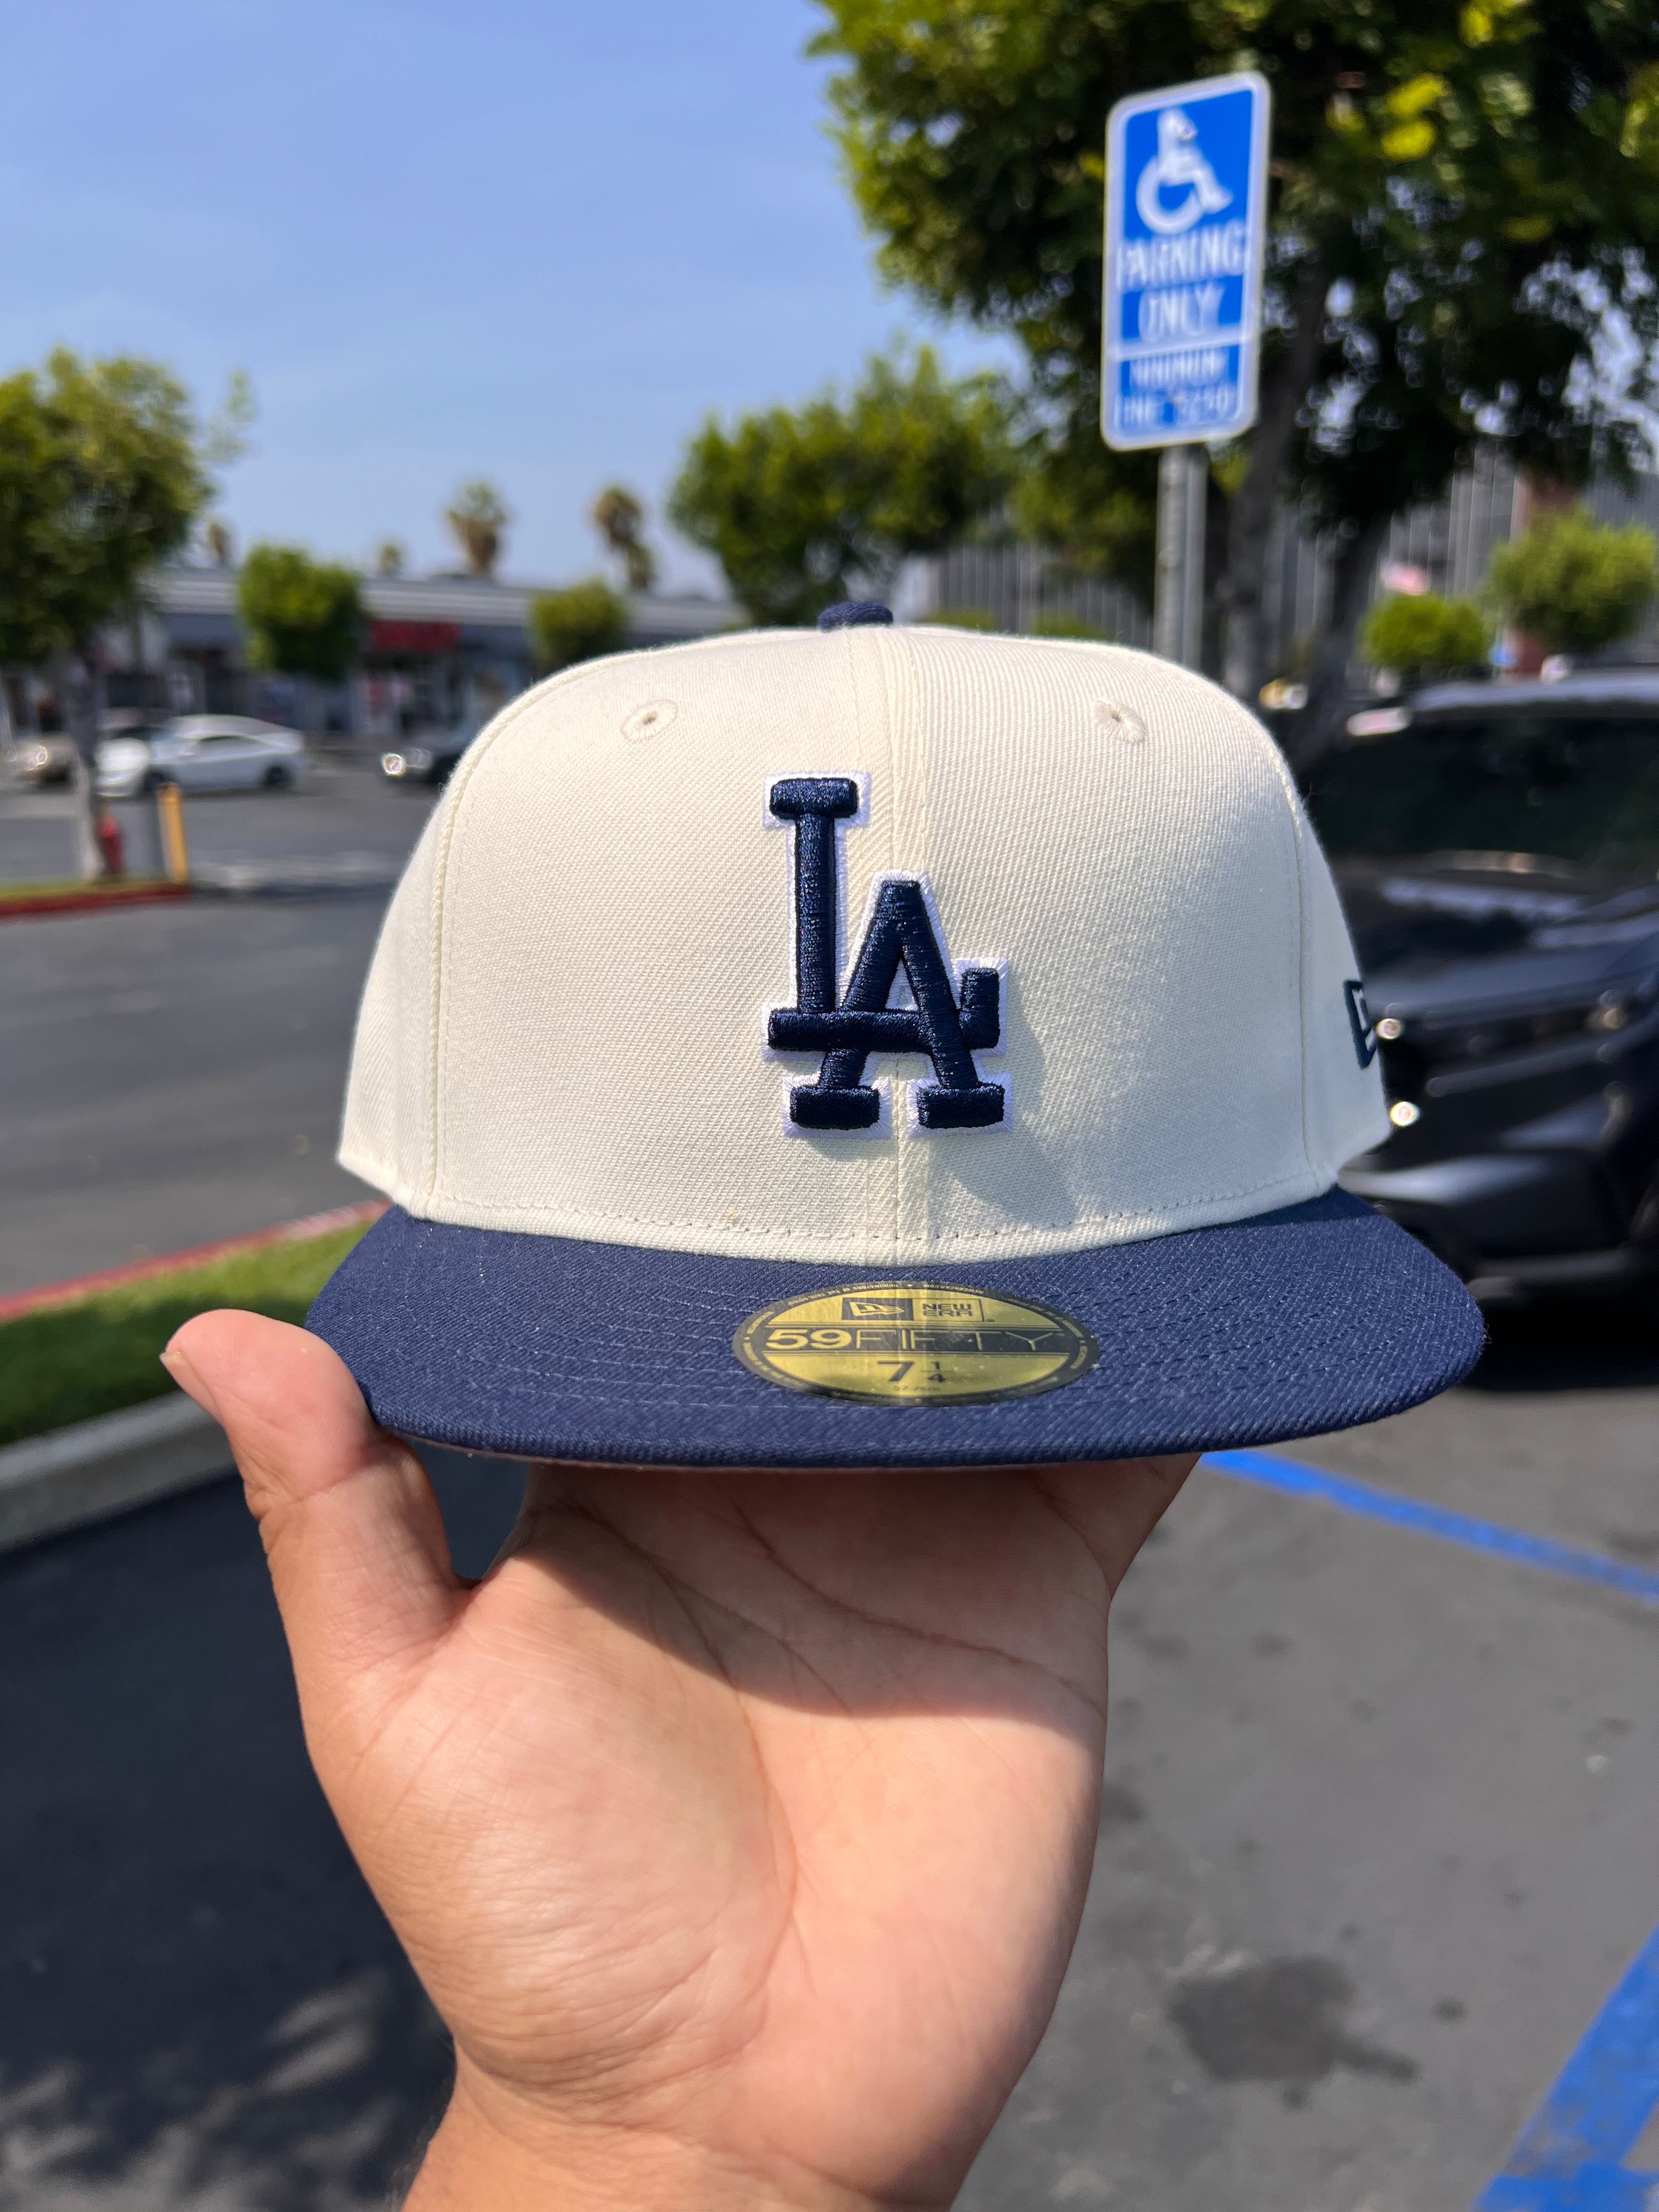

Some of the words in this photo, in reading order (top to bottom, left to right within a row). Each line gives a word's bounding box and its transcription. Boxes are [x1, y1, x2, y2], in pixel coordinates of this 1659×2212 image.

[1117, 218, 1245, 290] PARKING
[1138, 281, 1224, 343] ONLY
[766, 775, 1007, 1131] LA
[766, 1329, 1053, 1351] 59FIFTY
